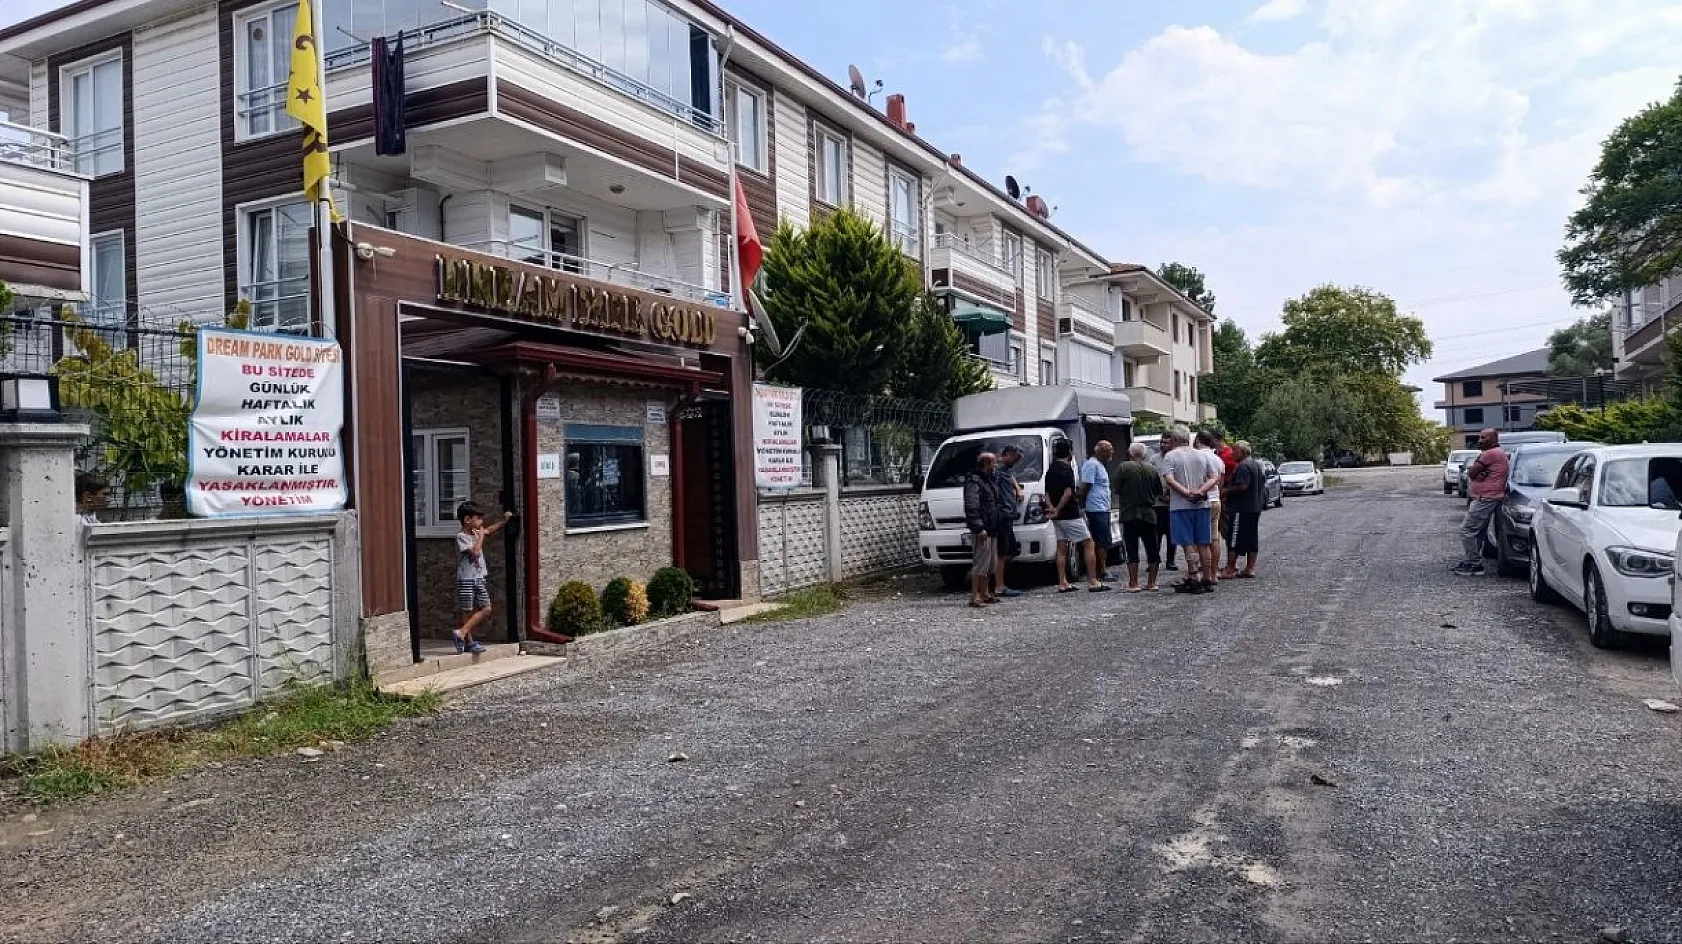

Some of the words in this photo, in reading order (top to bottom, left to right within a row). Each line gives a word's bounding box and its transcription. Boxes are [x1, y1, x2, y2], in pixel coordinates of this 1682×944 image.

[207, 337, 249, 357] DREAM
[253, 342, 282, 360] PARK
[286, 345, 312, 362] GOLD
[242, 365, 263, 376] BU
[269, 365, 315, 378] SİTEDE
[250, 381, 311, 395] GÜNLÜK
[241, 399, 315, 410] HAFTALIK
[221, 427, 330, 441] KİRALAMALAR
[204, 446, 283, 458] YÖNETİM
[237, 464, 294, 476] KARAR
[299, 462, 319, 474] İLE
[241, 493, 313, 507] YÖNETİM
